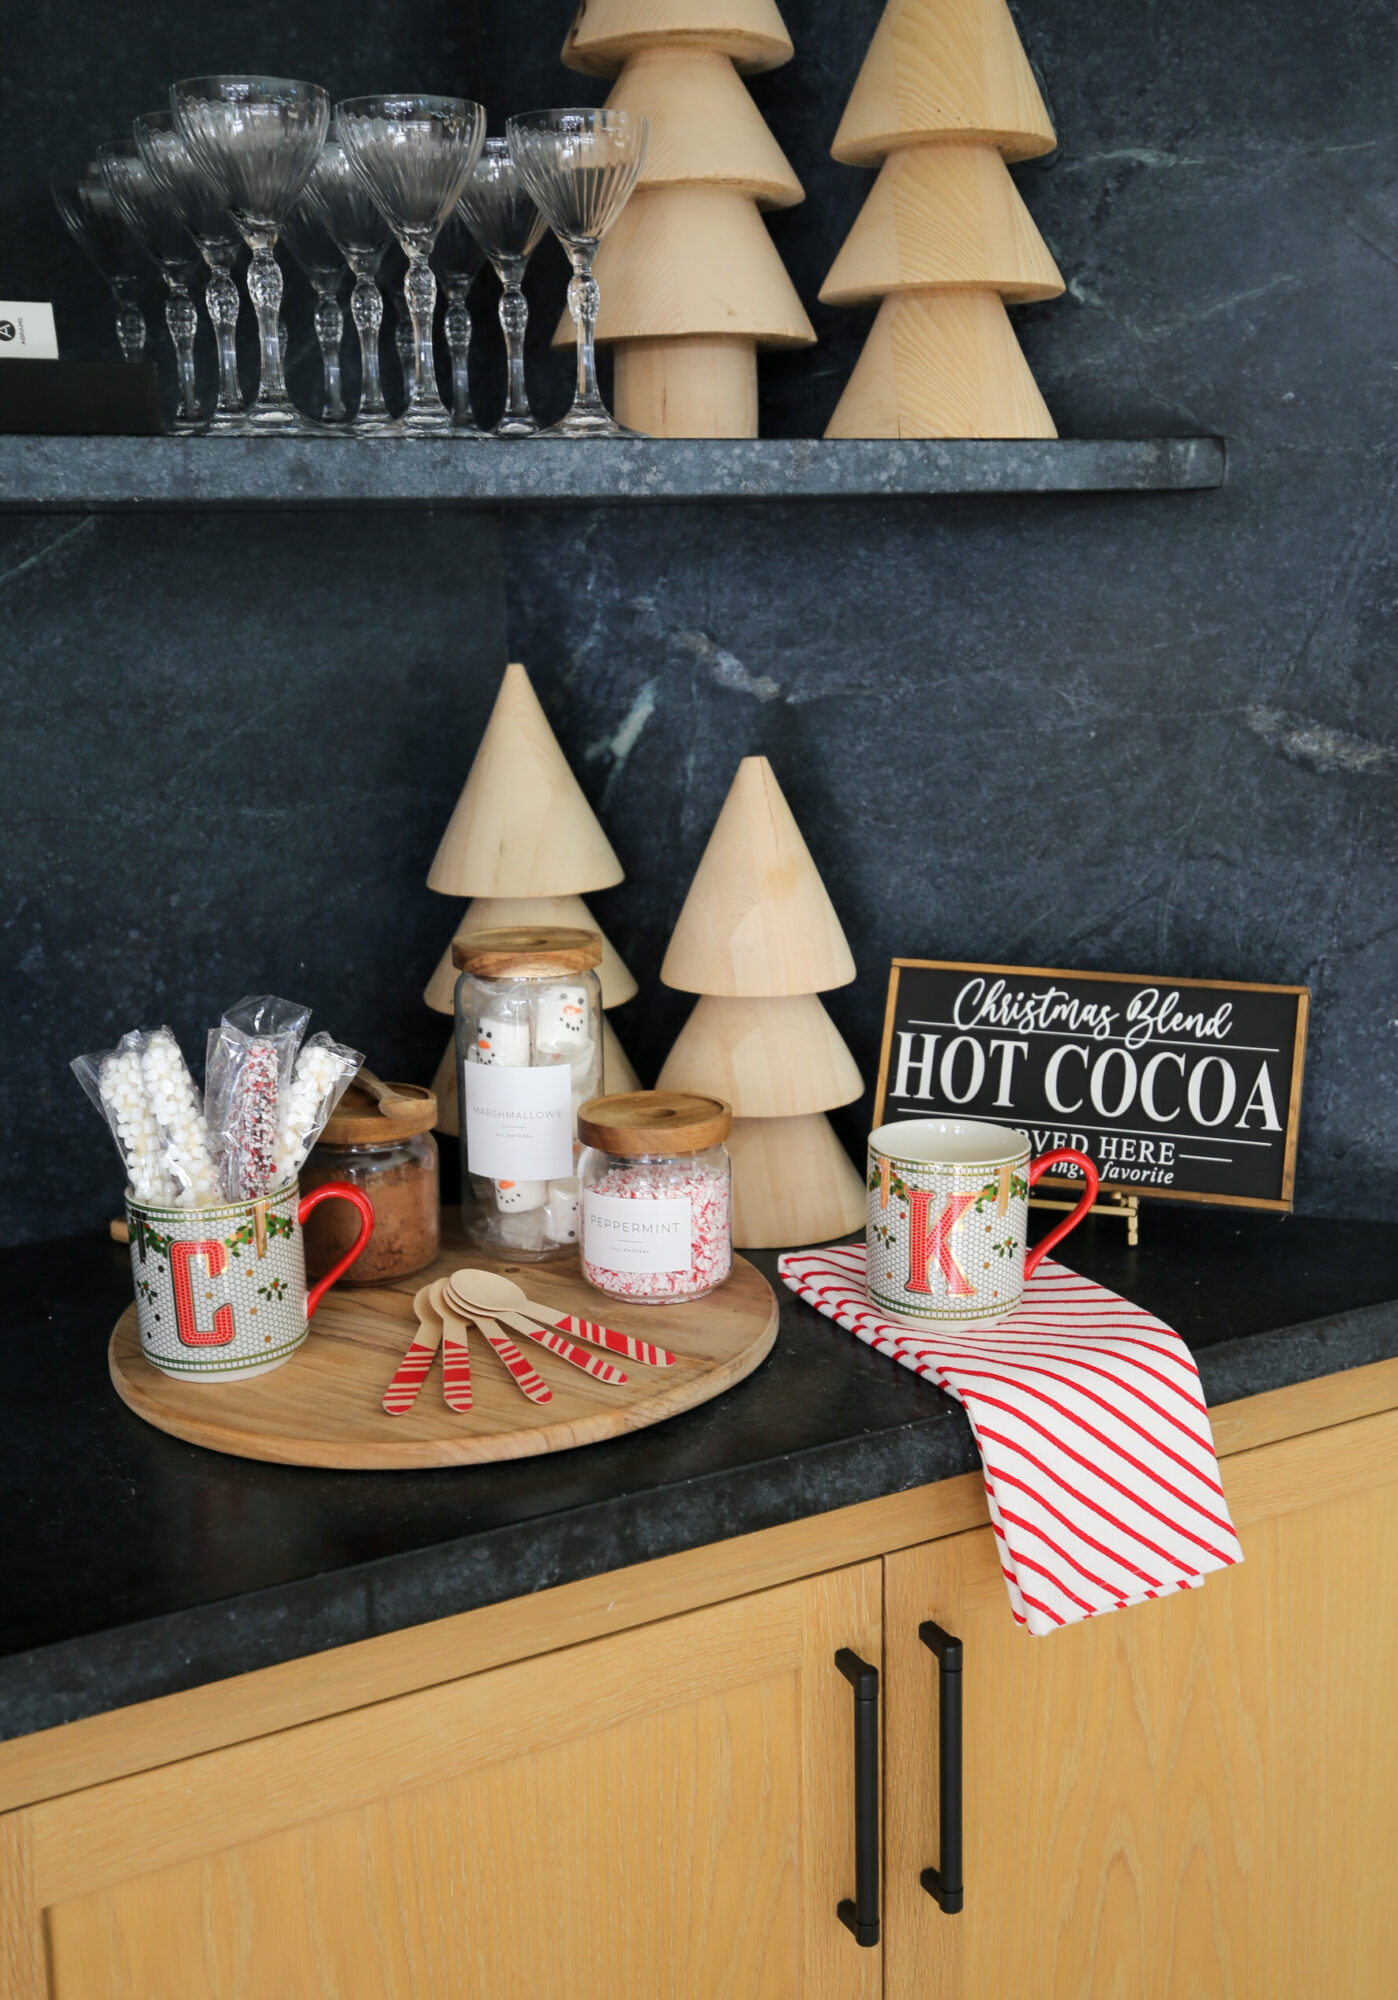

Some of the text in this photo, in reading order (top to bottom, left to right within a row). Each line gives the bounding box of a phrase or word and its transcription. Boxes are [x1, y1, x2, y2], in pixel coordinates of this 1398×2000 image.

[953, 977, 1233, 1050] Christmas Blend
[889, 1031, 1283, 1132] HOT COCOA
[472, 1106, 562, 1120] MARSHMALLOWS
[1098, 1136, 1175, 1166] HERE
[1098, 1161, 1174, 1185] favorite
[590, 1214, 680, 1233] PEPPERMINT
[904, 1188, 980, 1297] K
[168, 1239, 236, 1348] C
